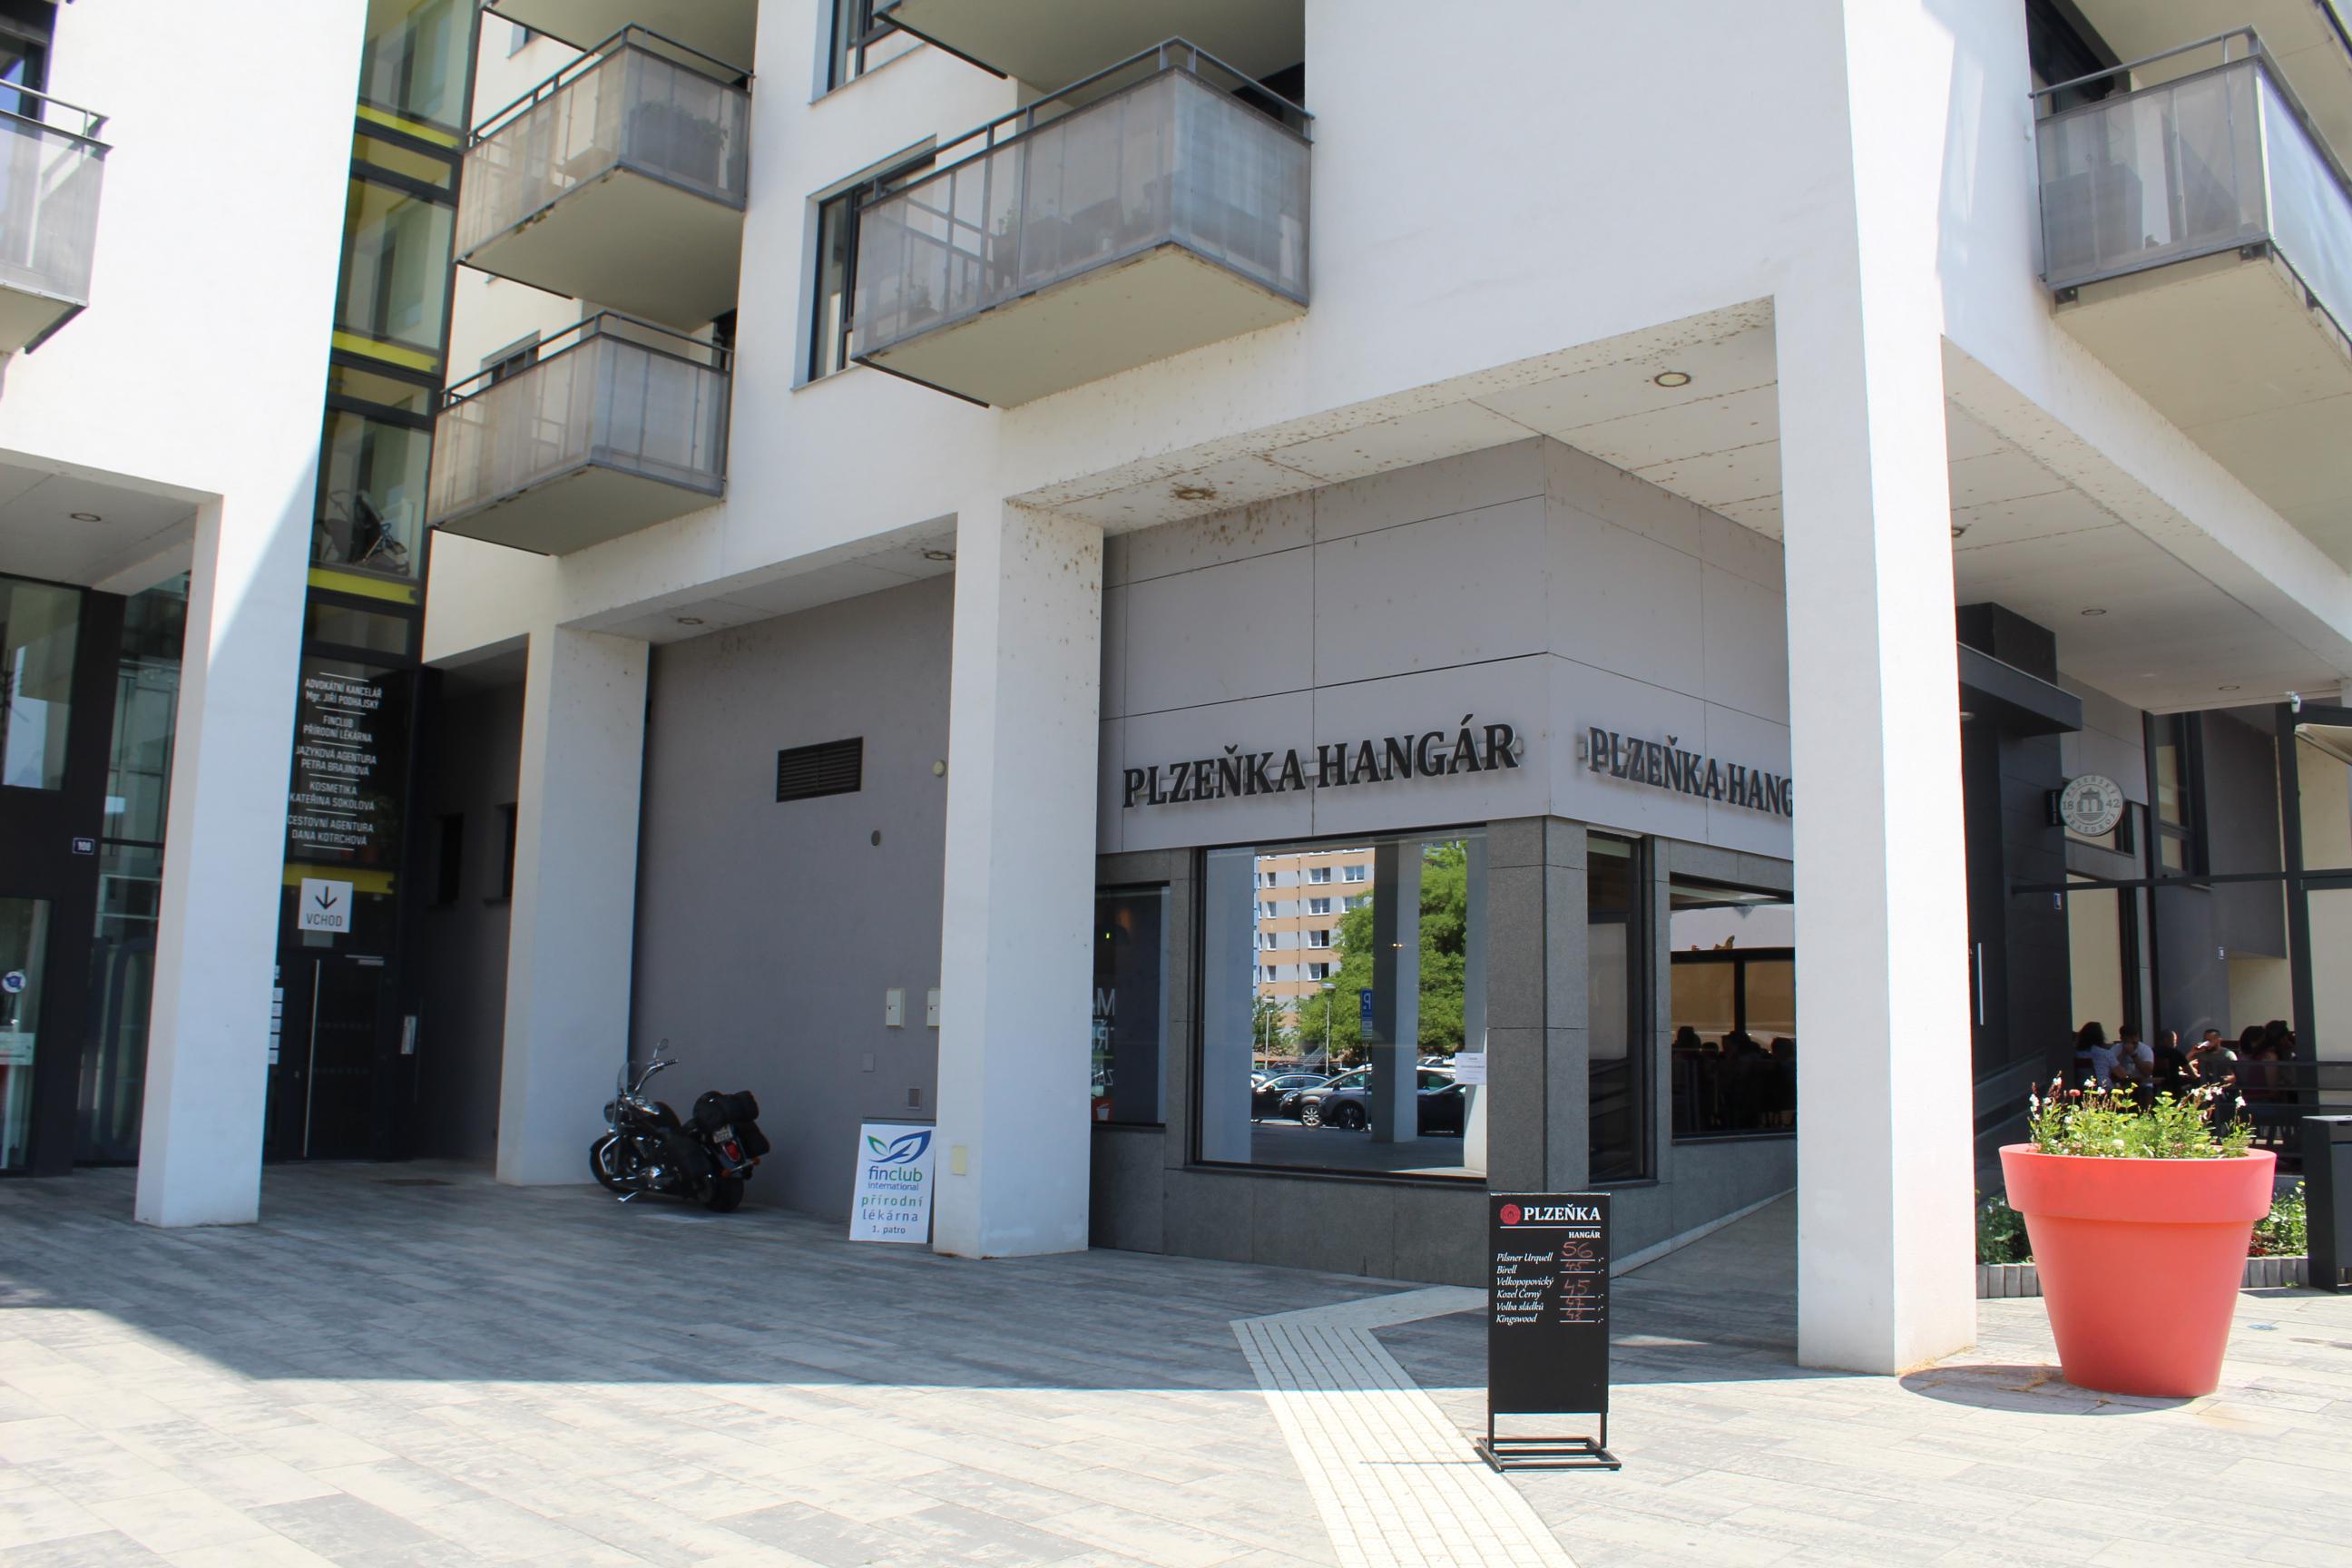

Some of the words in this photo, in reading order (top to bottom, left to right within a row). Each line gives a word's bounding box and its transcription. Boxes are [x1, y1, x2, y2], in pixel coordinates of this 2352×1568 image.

[323, 714, 354, 728] FINCLUB
[296, 745, 335, 759] JAZYKOVÁ
[336, 750, 377, 765] AGENTURA
[1123, 744, 1306, 808] PLZEŇKA
[1317, 713, 1520, 789] HANGÁR
[301, 758, 327, 769] PETRA
[1589, 727, 1721, 800] PLZEŇKA
[309, 781, 358, 795] KOSMETIKA
[289, 792, 331, 806] KATEŘINA
[332, 798, 376, 811] SOKOLOVÁ
[2106, 799, 2120, 808] 42
[329, 819, 374, 833] AGENTURA
[291, 829, 317, 840] DANA
[306, 913, 343, 926] VCHOD
[868, 1165, 923, 1181] finclub
[867, 1181, 919, 1191] international
[861, 1194, 924, 1208] přírodní
[863, 1209, 918, 1222] lékárna
[1524, 1203, 1601, 1220] PLZEŇKA
[872, 1225, 880, 1233] 1.
[883, 1226, 906, 1235] patro
[1568, 1230, 1601, 1239] HANGÁR
[1496, 1252, 1524, 1262] Pilsner
[1524, 1252, 1553, 1264] Urquell
[1496, 1264, 1518, 1274] Birell
[1496, 1276, 1554, 1288] Velkopopovický
[1496, 1289, 1518, 1298] Kozel
[1518, 1288, 1542, 1300] Černý
[1496, 1302, 1517, 1311] Volba
[1518, 1301, 1544, 1311] sládků
[1496, 1313, 1538, 1326] Kingswood
